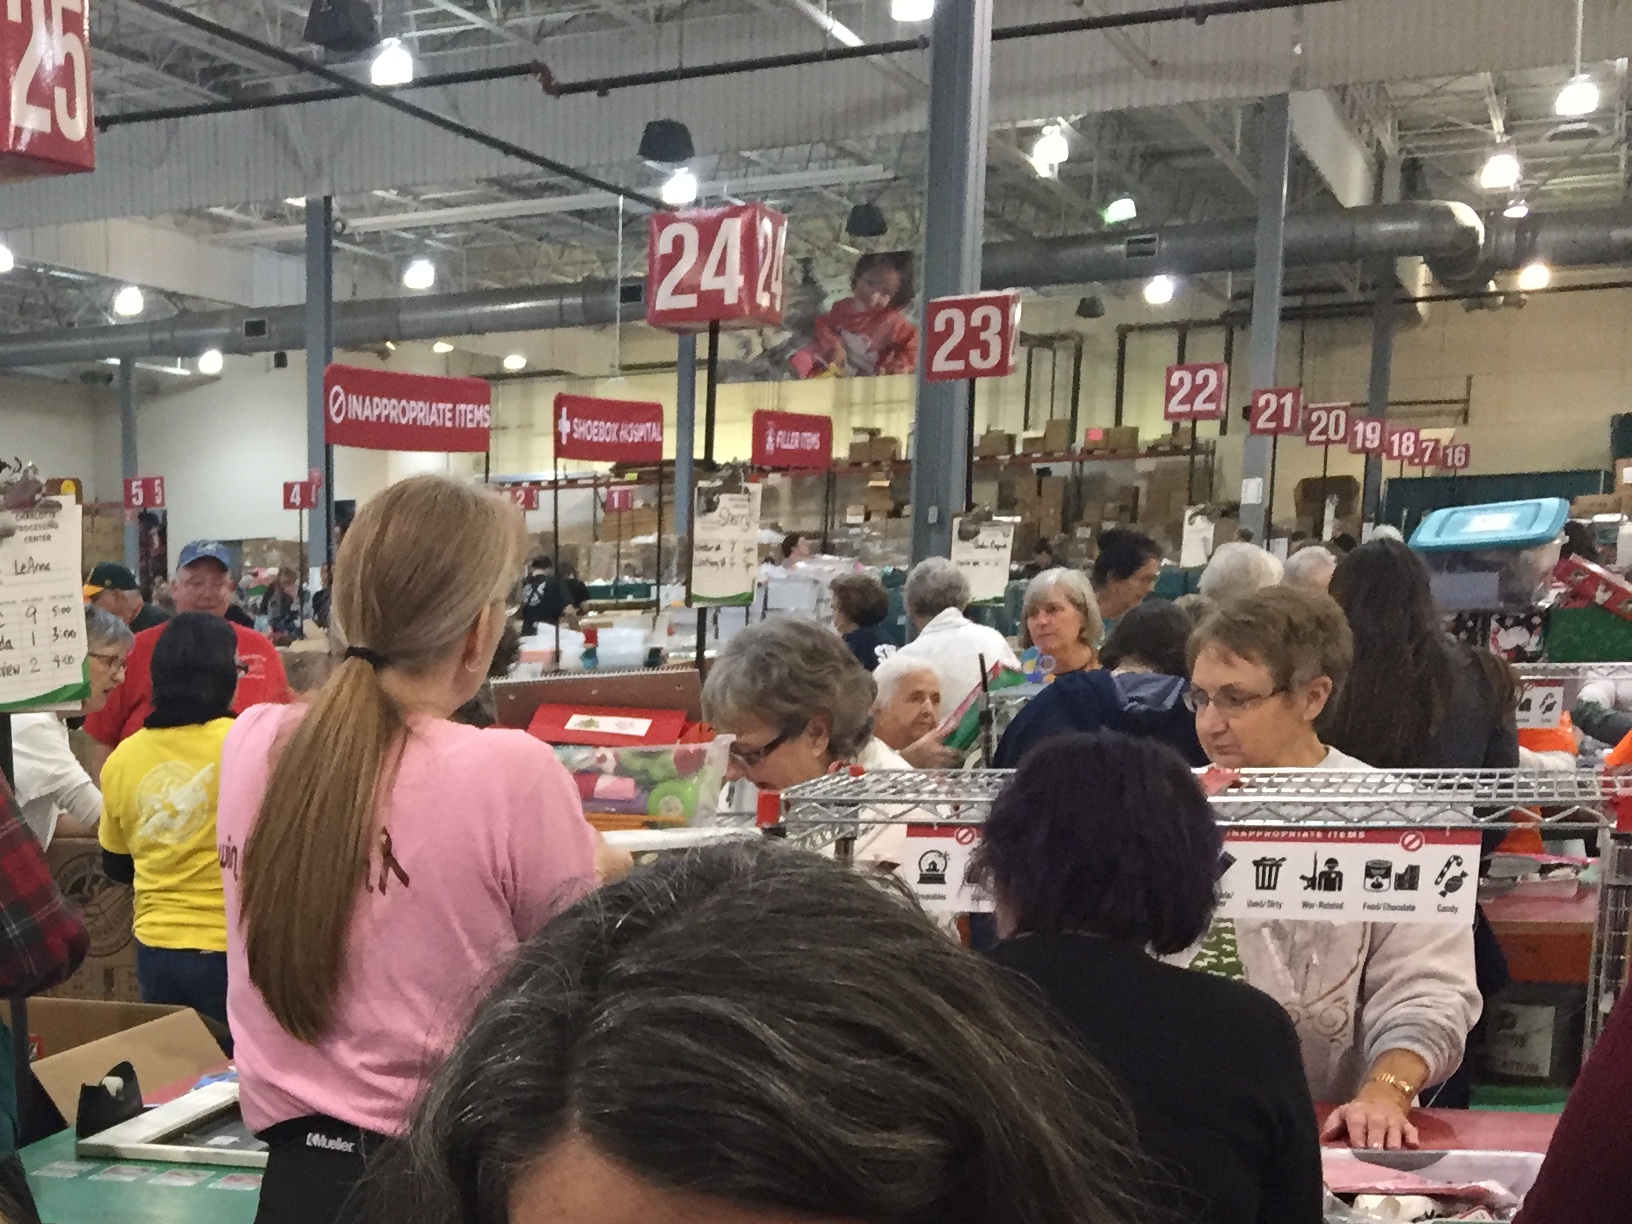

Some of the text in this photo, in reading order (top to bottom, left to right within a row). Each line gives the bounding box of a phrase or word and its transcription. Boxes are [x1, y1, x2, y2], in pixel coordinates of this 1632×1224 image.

[7, 0, 88, 142] 25
[655, 217, 745, 311] 24
[931, 304, 1003, 373] 23
[1168, 368, 1217, 413] 22
[347, 393, 490, 429] INAPPROPRIATE ITEMS
[1256, 391, 1294, 430] 21
[572, 417, 663, 443] SHOEBOX HOSPITAL
[1308, 408, 1347, 442] 20
[1353, 420, 1382, 449] 19
[776, 431, 821, 450] FILLER ITEMS
[1390, 430, 1415, 457] 18
[1414, 442, 1434, 463] 7
[1445, 444, 1466, 467] 16
[131, 480, 144, 506] 5
[153, 479, 162, 505] 5
[289, 484, 302, 506] 4
[515, 489, 526, 509] 2
[612, 491, 619, 509] 1
[25, 605, 37, 625] 9
[29, 657, 40, 673] 2
